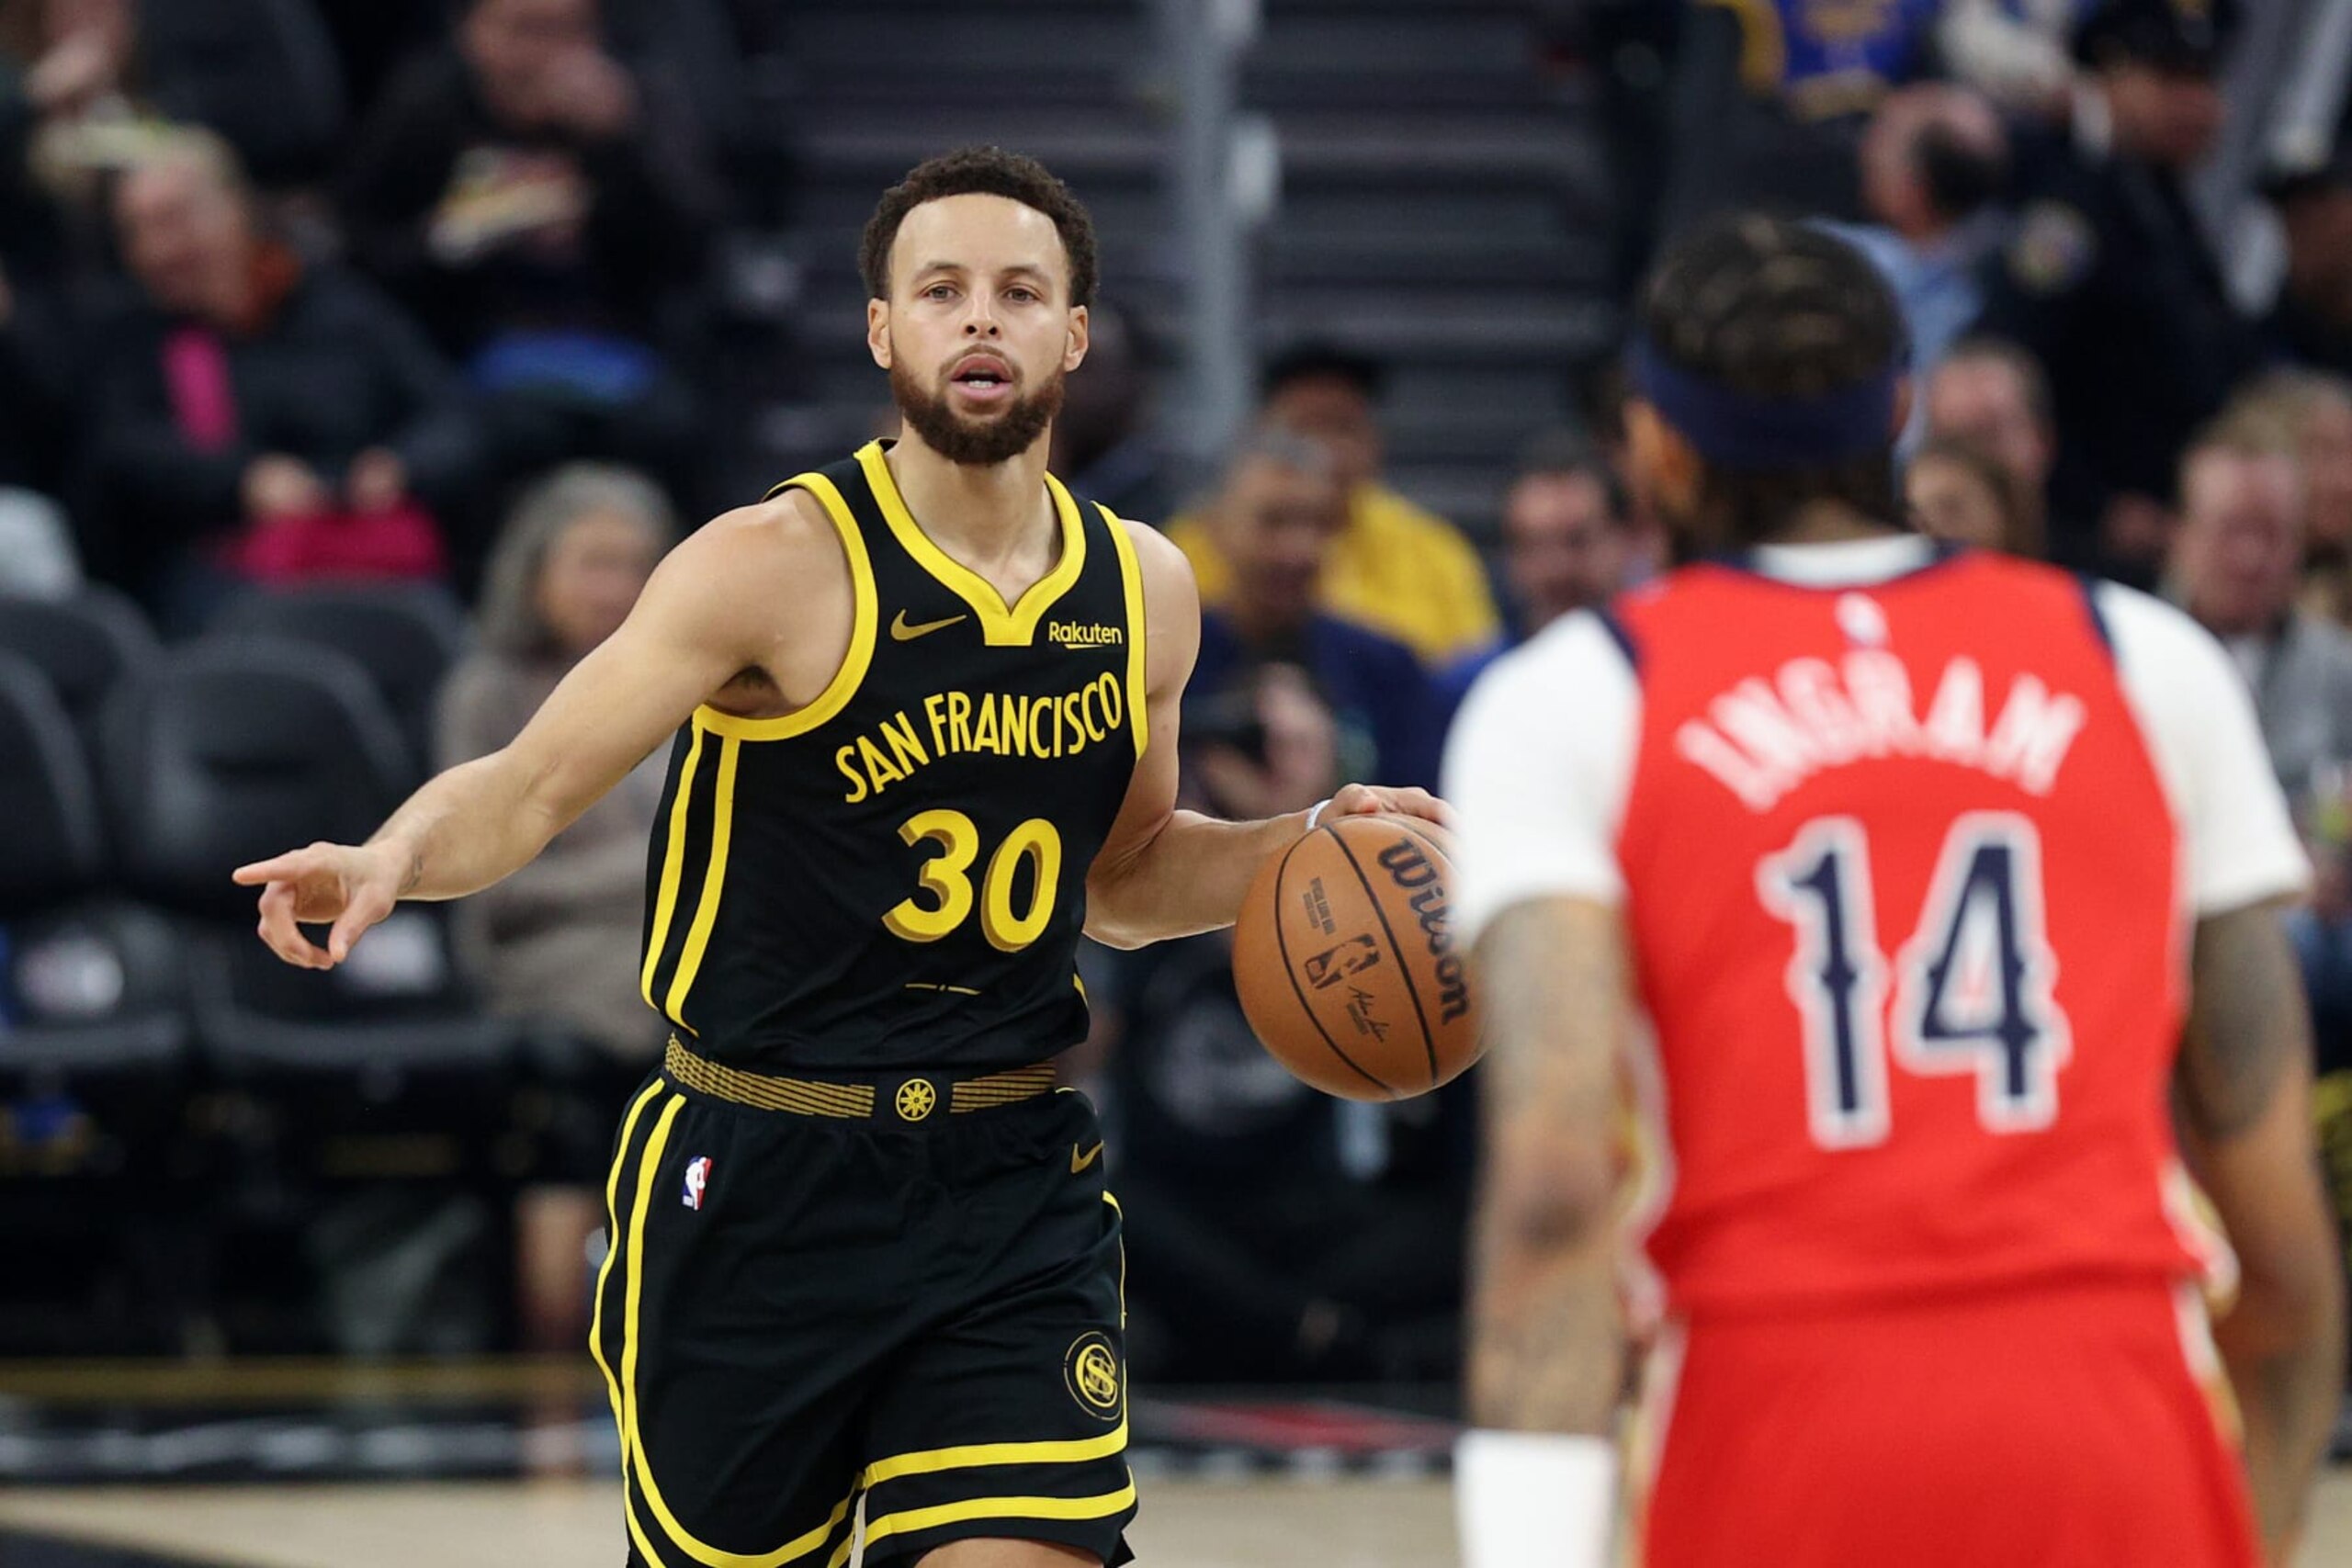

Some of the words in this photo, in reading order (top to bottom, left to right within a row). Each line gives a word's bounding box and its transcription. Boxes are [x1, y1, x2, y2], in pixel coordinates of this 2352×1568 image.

[1048, 621, 1123, 646] Rakuten
[835, 710, 930, 804] SAN
[923, 671, 1123, 760] FRANCISCO
[1676, 653, 2086, 811] INGRAM
[882, 809, 1062, 953] 30
[1377, 837, 1470, 1025] Wilson
[1756, 812, 2072, 1149] 14
